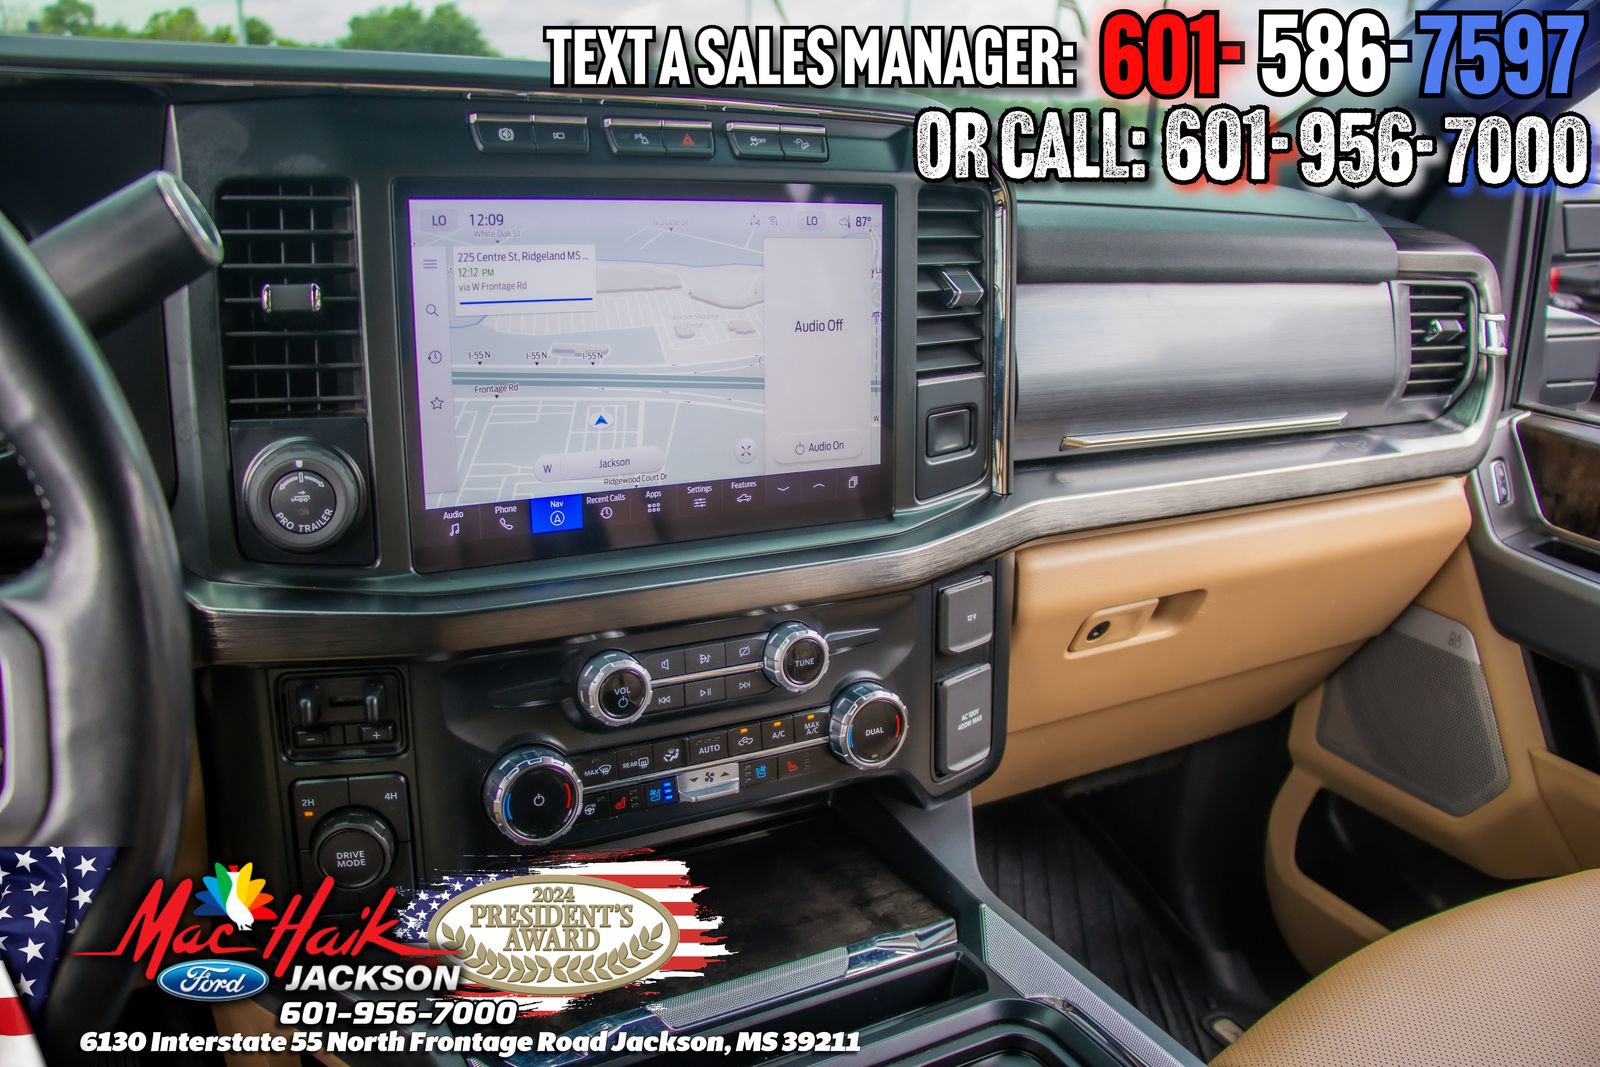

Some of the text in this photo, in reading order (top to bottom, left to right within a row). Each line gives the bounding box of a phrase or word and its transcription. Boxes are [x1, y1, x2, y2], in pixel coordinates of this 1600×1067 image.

[432, 214, 504, 226] LO 12:09
[806, 216, 872, 228] LO 87°
[473, 230, 495, 238] White
[458, 252, 475, 263] 225
[476, 252, 507, 262] Centre
[508, 252, 520, 262] St,
[522, 251, 566, 263] Ridgeland
[567, 251, 581, 261] MS
[458, 268, 494, 278] 12:12 PM
[458, 282, 528, 292] via W Frontage Rd
[794, 319, 844, 332] Audio Off
[468, 351, 484, 359] I-55
[526, 352, 541, 360] I-55
[596, 352, 603, 360] N
[474, 384, 518, 394] Frontage Rd
[808, 441, 844, 452] Audio On
[599, 458, 630, 469] Jackson
[543, 464, 552, 474] W
[603, 472, 668, 487] Ridgewood Court Dr
[687, 484, 713, 494] Settings
[731, 480, 757, 490] Features
[586, 493, 626, 504] Recent Calls
[645, 489, 662, 499] Apps
[494, 504, 517, 514] Phone
[550, 500, 564, 508] Nav
[443, 510, 464, 520] Audio
[275, 508, 334, 533] PRO TRAILER
[794, 657, 815, 668] TUNE
[614, 687, 632, 696] VOL
[804, 721, 820, 730] MAX
[772, 730, 786, 740] A/C
[806, 726, 820, 736] A/C
[865, 726, 884, 738] DUAL
[698, 744, 721, 755] AUTO
[622, 760, 638, 770] REAR
[584, 768, 600, 777] MAX
[384, 792, 398, 800] 4H
[302, 798, 315, 808] 2H
[336, 850, 365, 860] DRIVE
[337, 859, 366, 868] MODE
